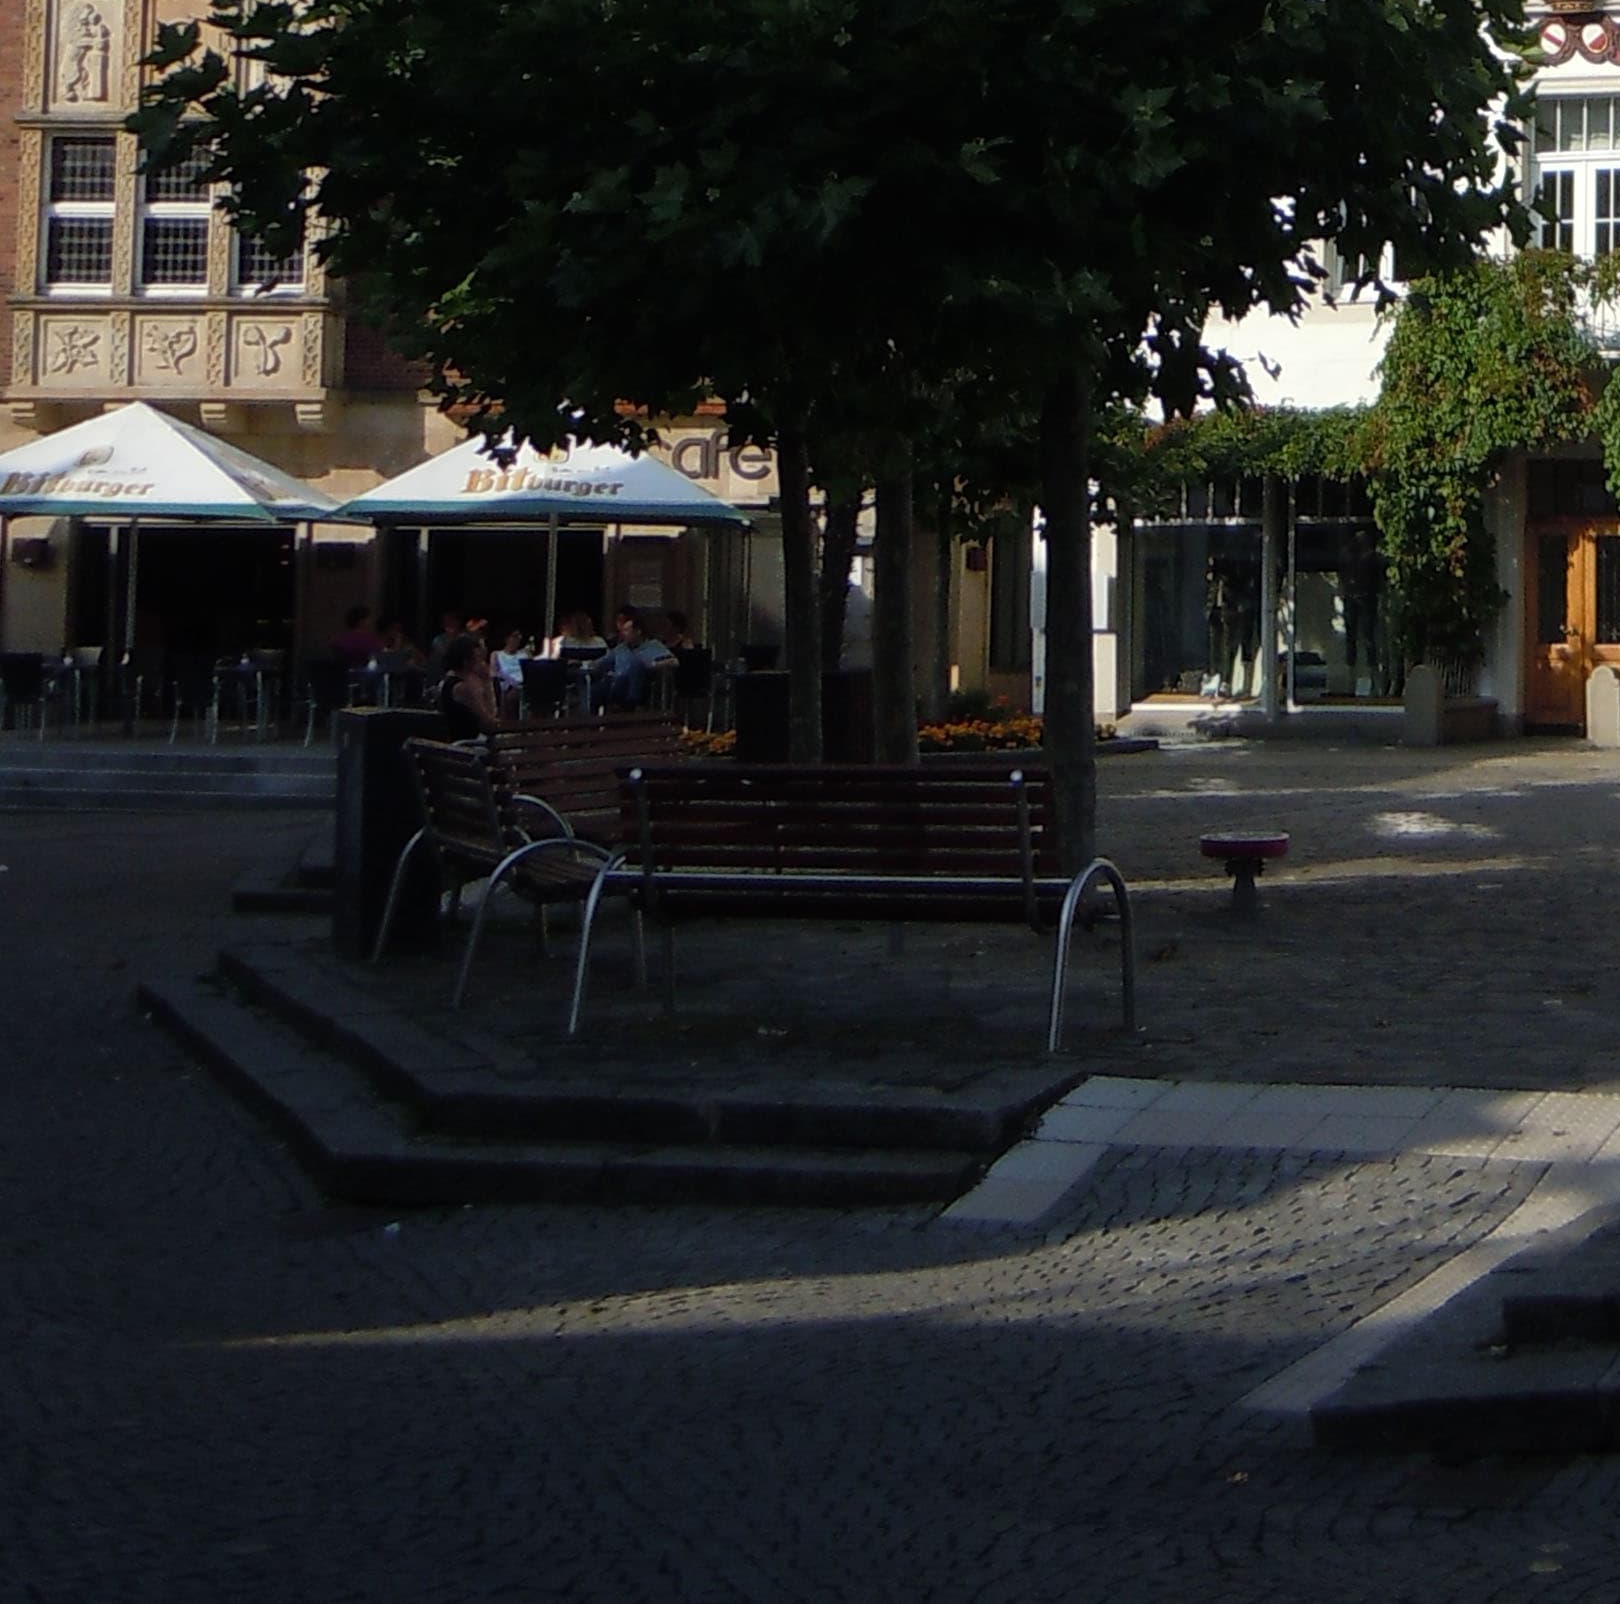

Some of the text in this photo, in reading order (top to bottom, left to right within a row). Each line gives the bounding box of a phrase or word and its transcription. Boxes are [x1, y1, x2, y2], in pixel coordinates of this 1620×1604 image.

[655, 429, 773, 481] afe
[1, 471, 155, 498] Bitburger
[461, 468, 625, 497] Bitburger
